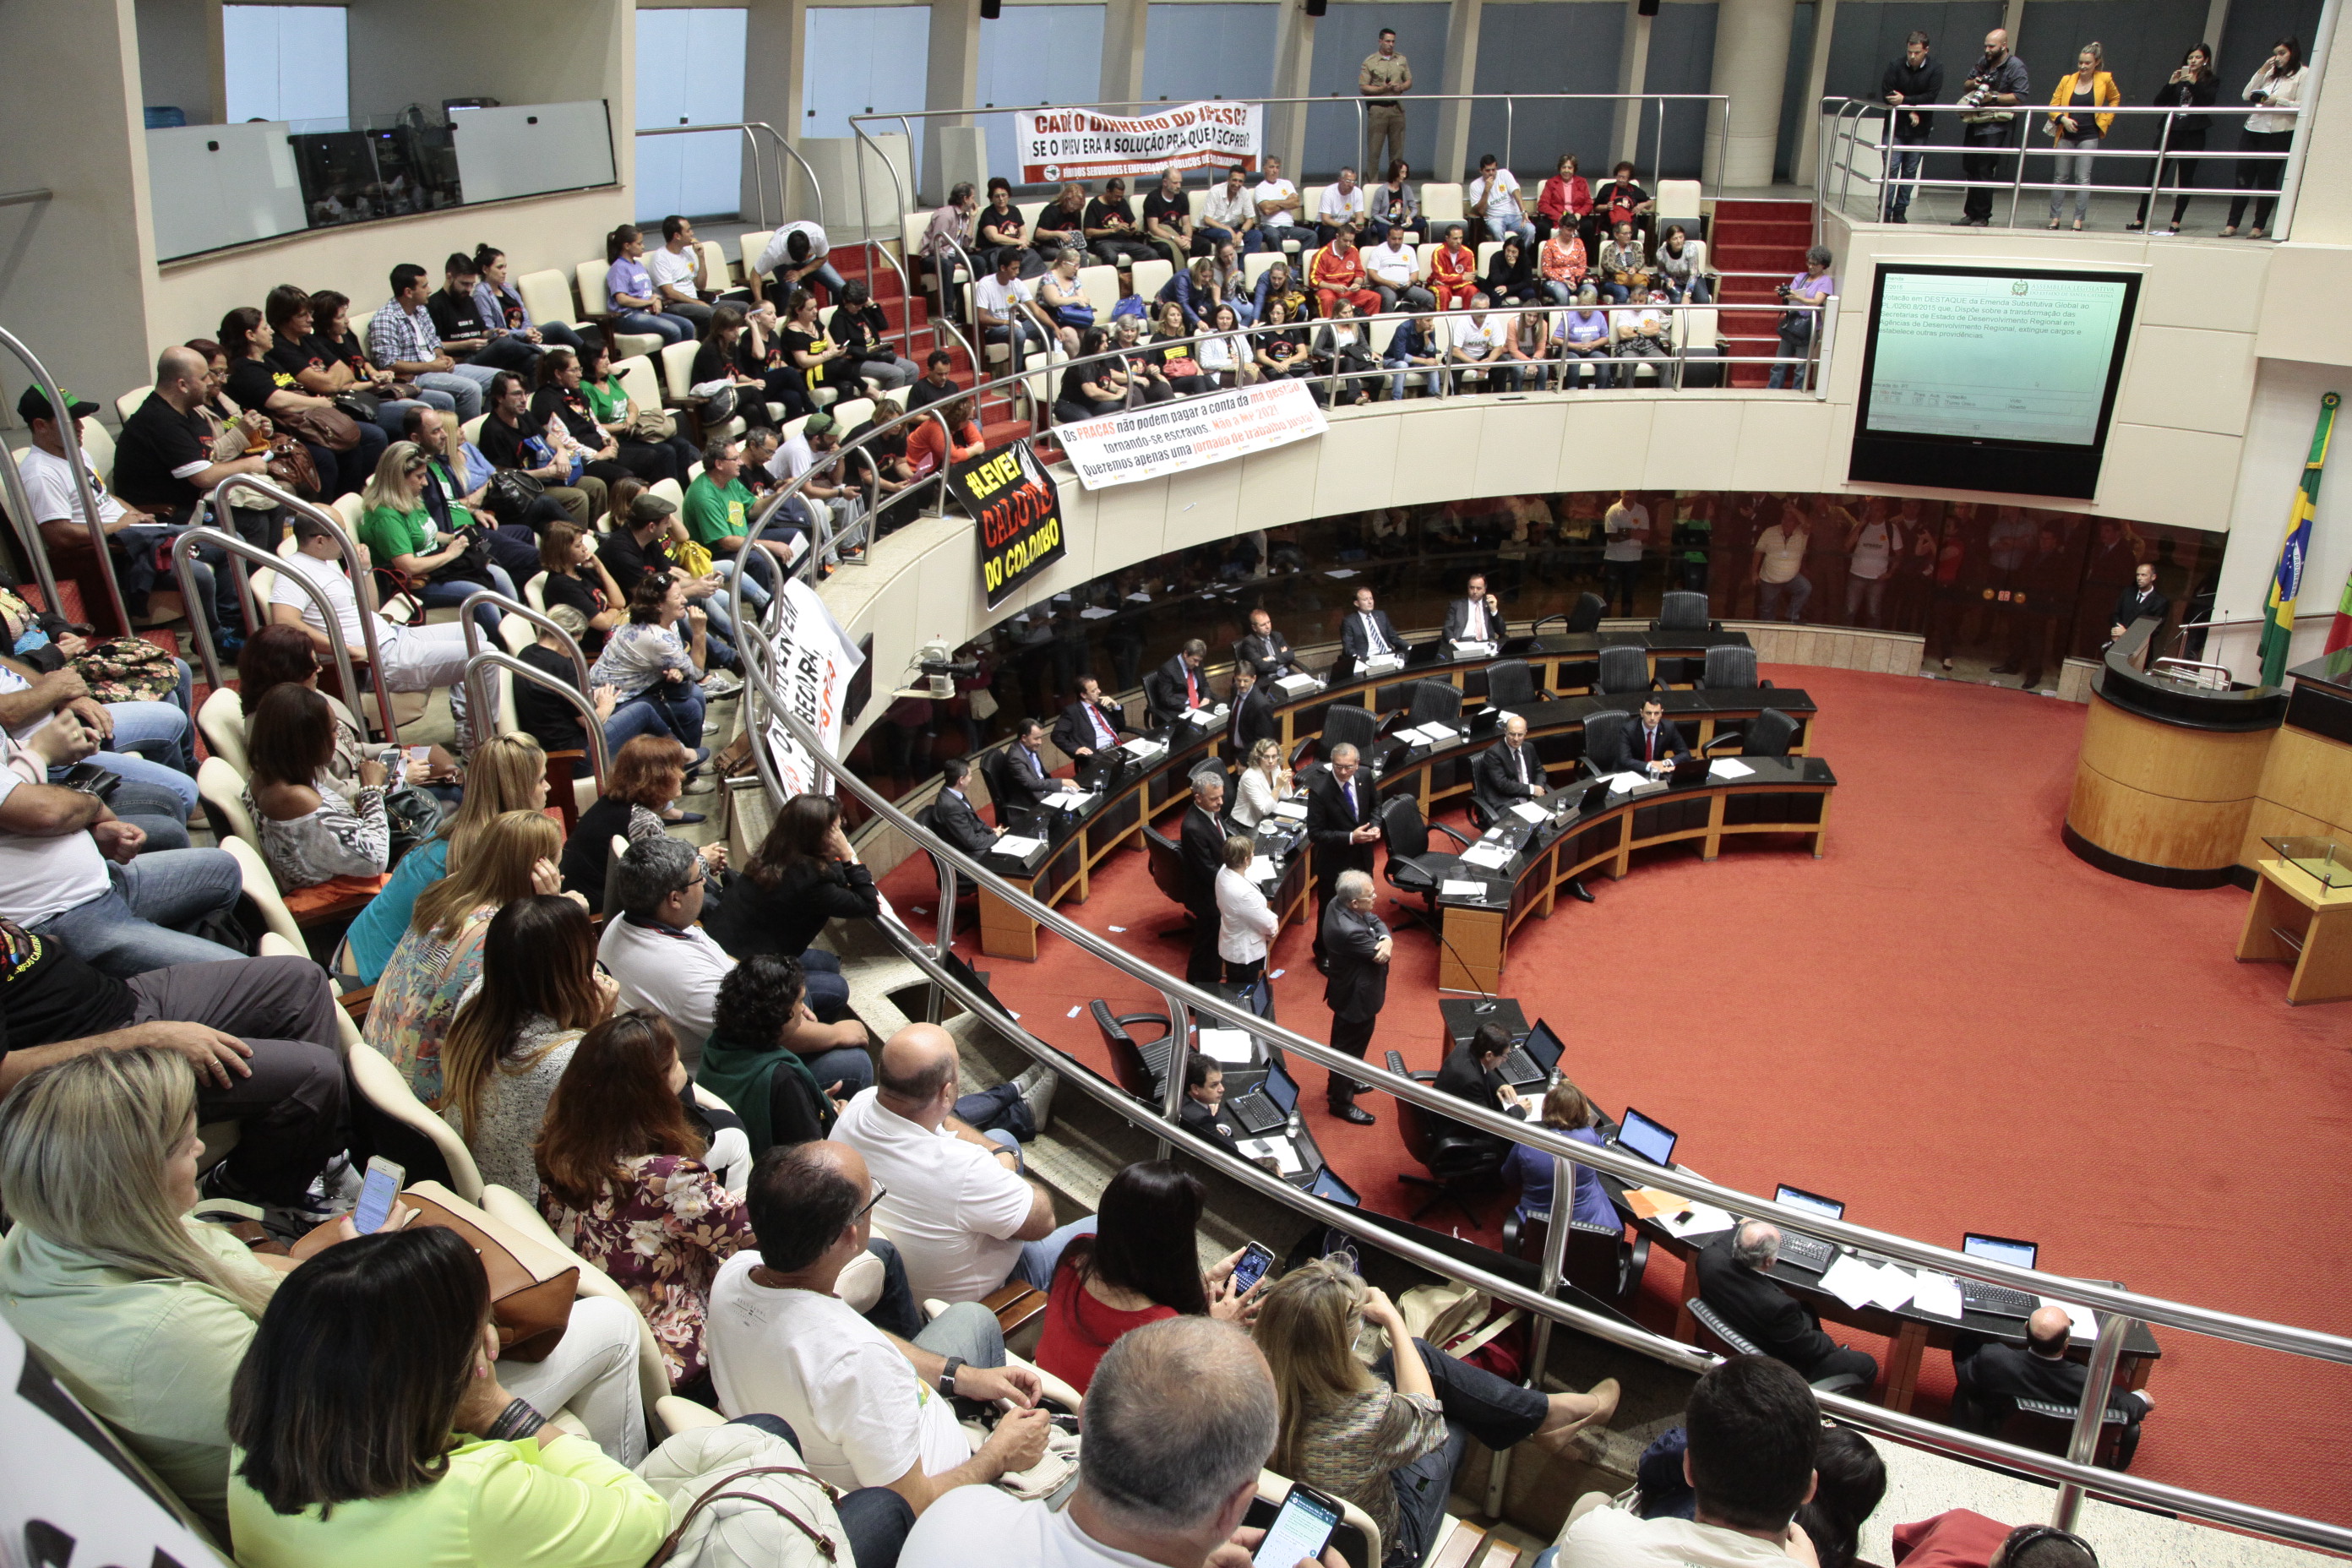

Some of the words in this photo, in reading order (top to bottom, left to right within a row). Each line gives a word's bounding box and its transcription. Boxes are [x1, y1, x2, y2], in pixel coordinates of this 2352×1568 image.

[1074, 113, 1085, 133] O
[1090, 116, 1170, 133] DINHEIRO
[1171, 111, 1195, 127] DO
[1199, 105, 1247, 126] IPESC?
[1032, 140, 1047, 157] SE
[1050, 139, 1059, 155] O
[1083, 139, 1102, 155] ERA
[1105, 137, 1112, 153] A
[1189, 127, 1211, 148] QUE
[1217, 128, 1250, 148] SCPREV?
[1086, 164, 1124, 177] SERVIDORES
[1124, 164, 1128, 174] E
[1128, 161, 1169, 174] EMPREGADOS
[1169, 156, 1201, 169] PÚBLICOS
[1201, 154, 1210, 166] DE
[1955, 305, 1979, 314] Dispõe
[2010, 308, 2061, 318] transformação
[1979, 298, 2010, 307] Emenda
[2012, 300, 2053, 308] Substitutiva
[1923, 322, 1982, 330] Desenvolvimento
[2018, 326, 2048, 335] extingue
[1968, 315, 2028, 324] Desenvolvimento
[2029, 318, 2061, 328] Regional
[1063, 429, 1077, 443] Os
[1076, 422, 1115, 440] PRAÇAS
[1117, 418, 1135, 433] não
[1137, 414, 1170, 430] podem
[1171, 406, 1198, 422] pagar
[1201, 406, 1208, 415] a
[1209, 399, 1235, 414] conta
[1237, 395, 1250, 407] da
[1250, 389, 1266, 404] má
[1103, 434, 1163, 454] tornando-se
[1165, 424, 1211, 442] escravos.
[1211, 417, 1233, 431] Não
[1233, 416, 1239, 426] a
[1239, 411, 1255, 424] MP
[1255, 405, 1279, 421] 202!
[1083, 457, 1134, 477] Queremos
[1134, 449, 1170, 466] apenas
[1170, 444, 1192, 459] uma
[1232, 432, 1244, 444] de
[1245, 421, 1288, 439] trabalho
[984, 556, 1003, 592] DO
[1005, 517, 1059, 579] COLOMBO
